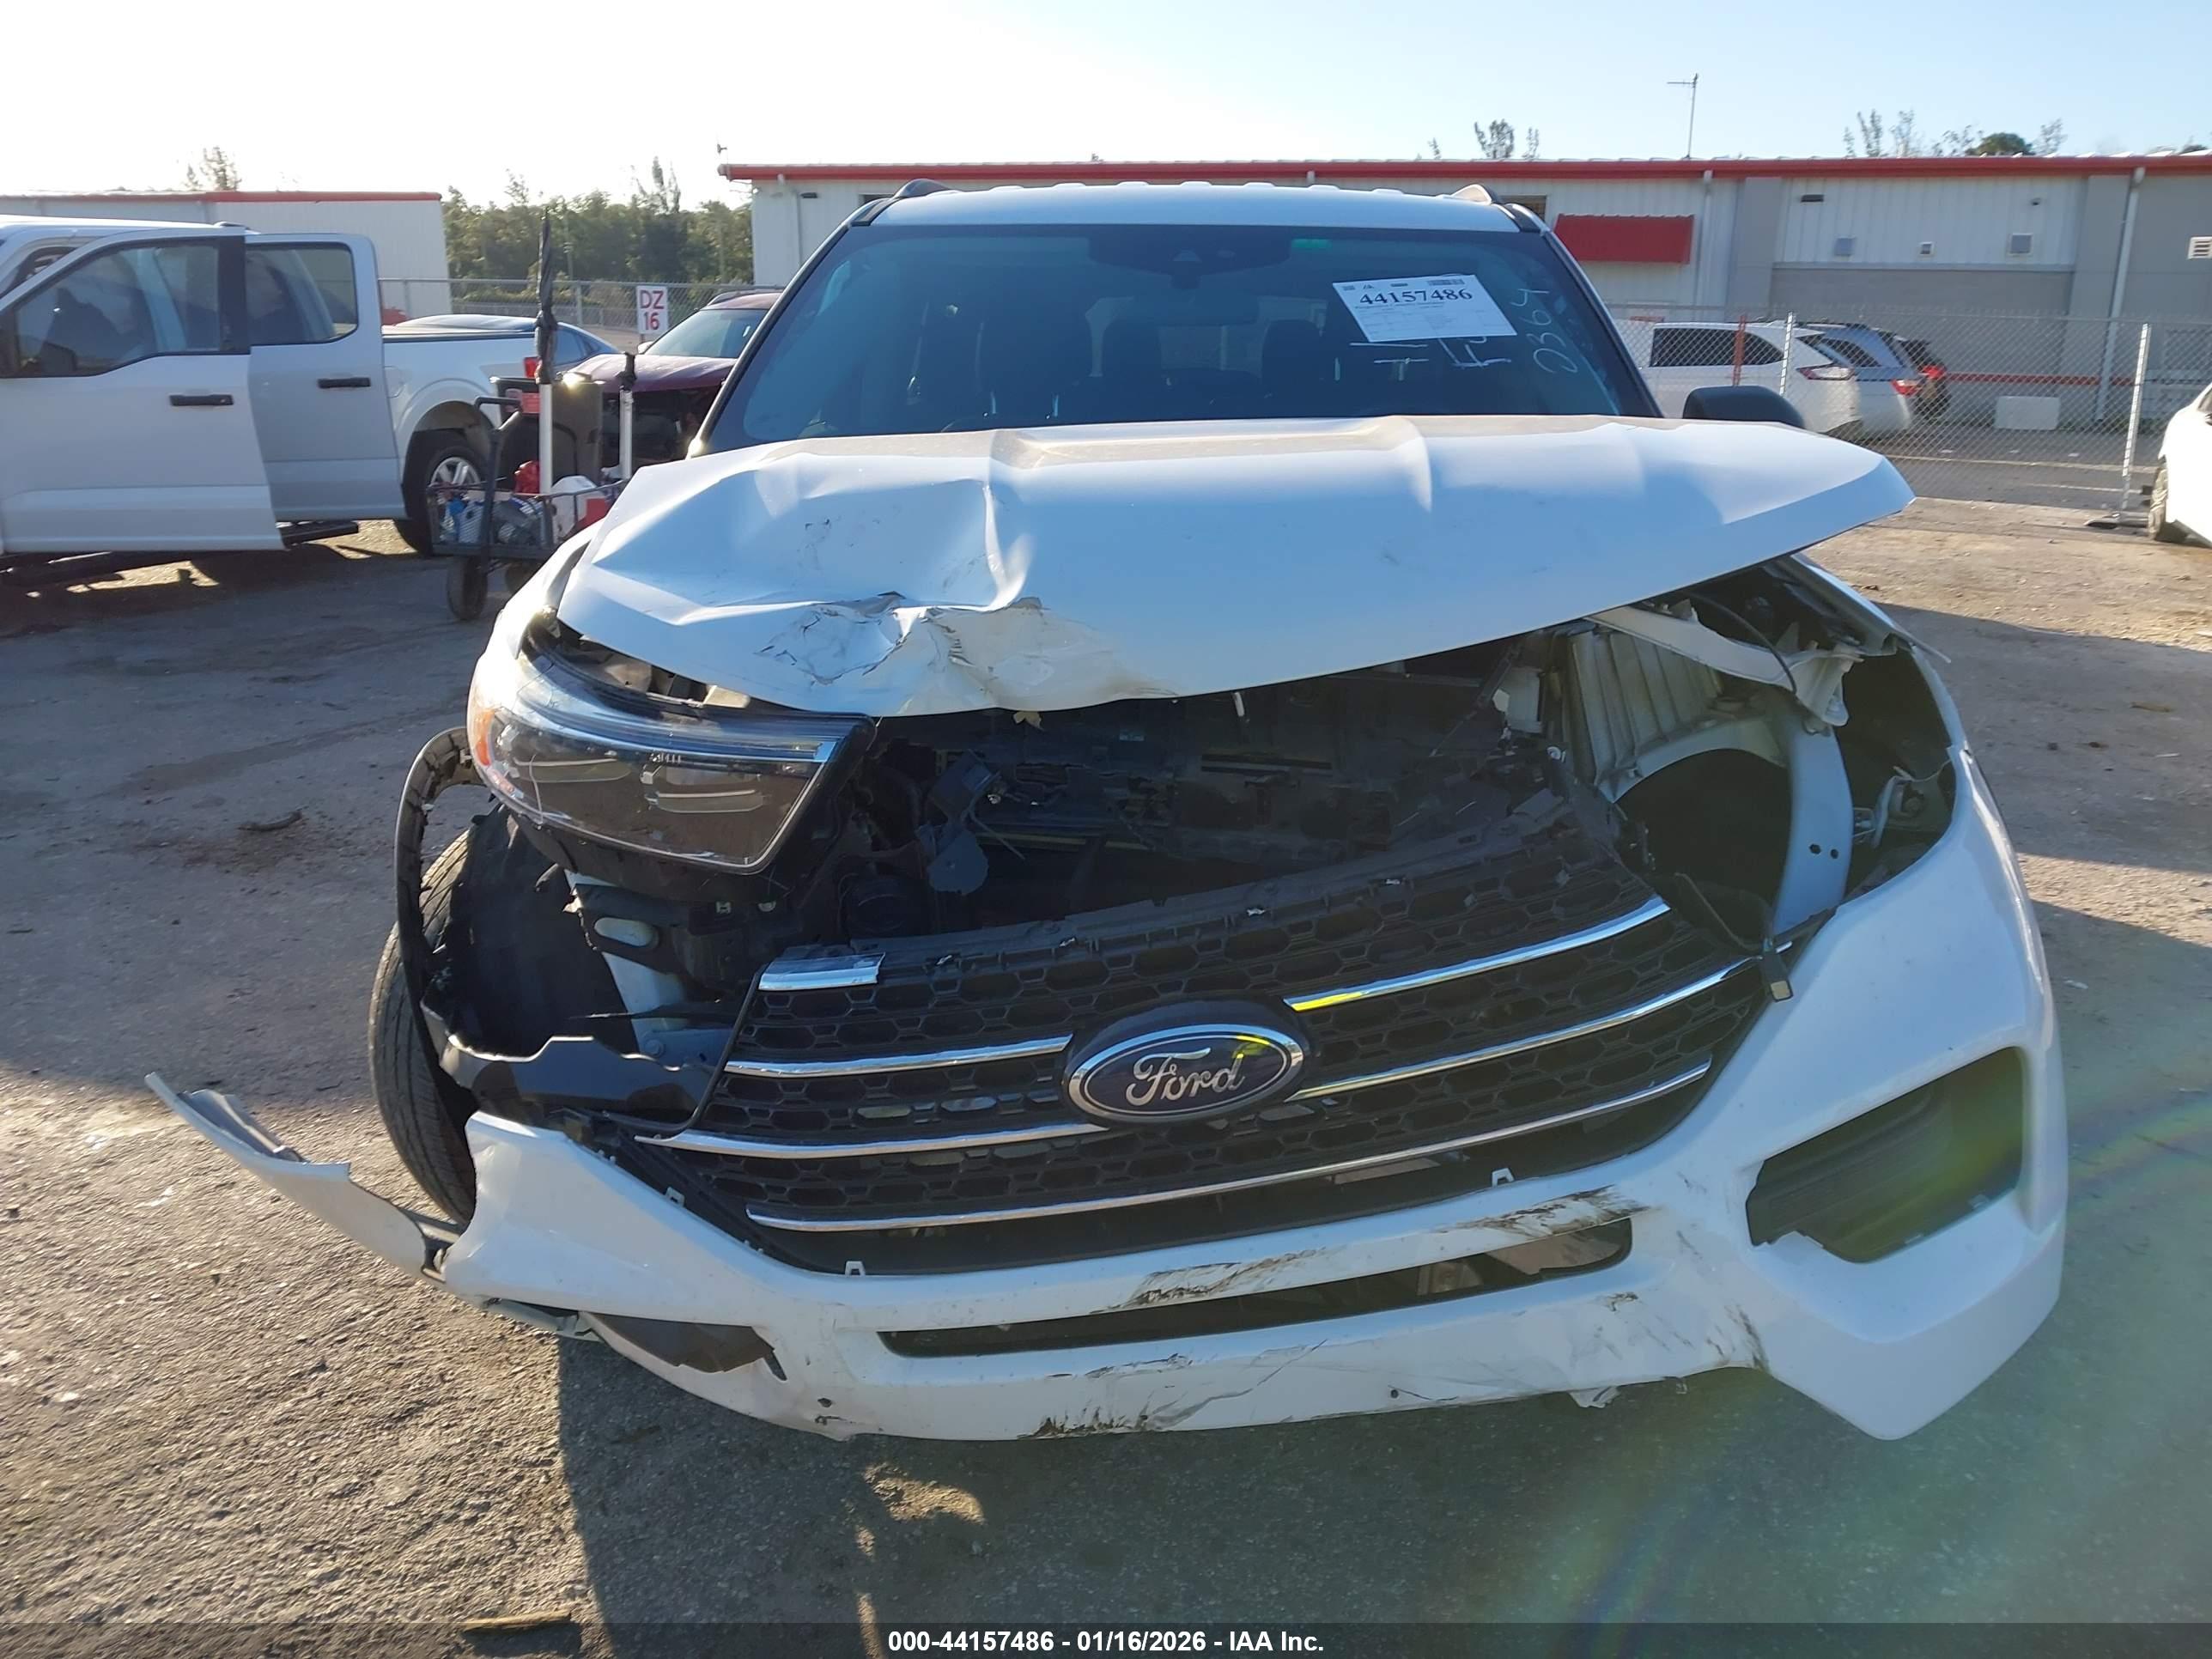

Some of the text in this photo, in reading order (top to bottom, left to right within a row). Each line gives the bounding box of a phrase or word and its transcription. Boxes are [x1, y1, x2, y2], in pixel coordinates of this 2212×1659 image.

[639, 289, 665, 309] DZ
[1359, 288, 1474, 305] 44157486
[643, 312, 659, 331] 16
[1125, 1047, 1245, 1106] Ford
